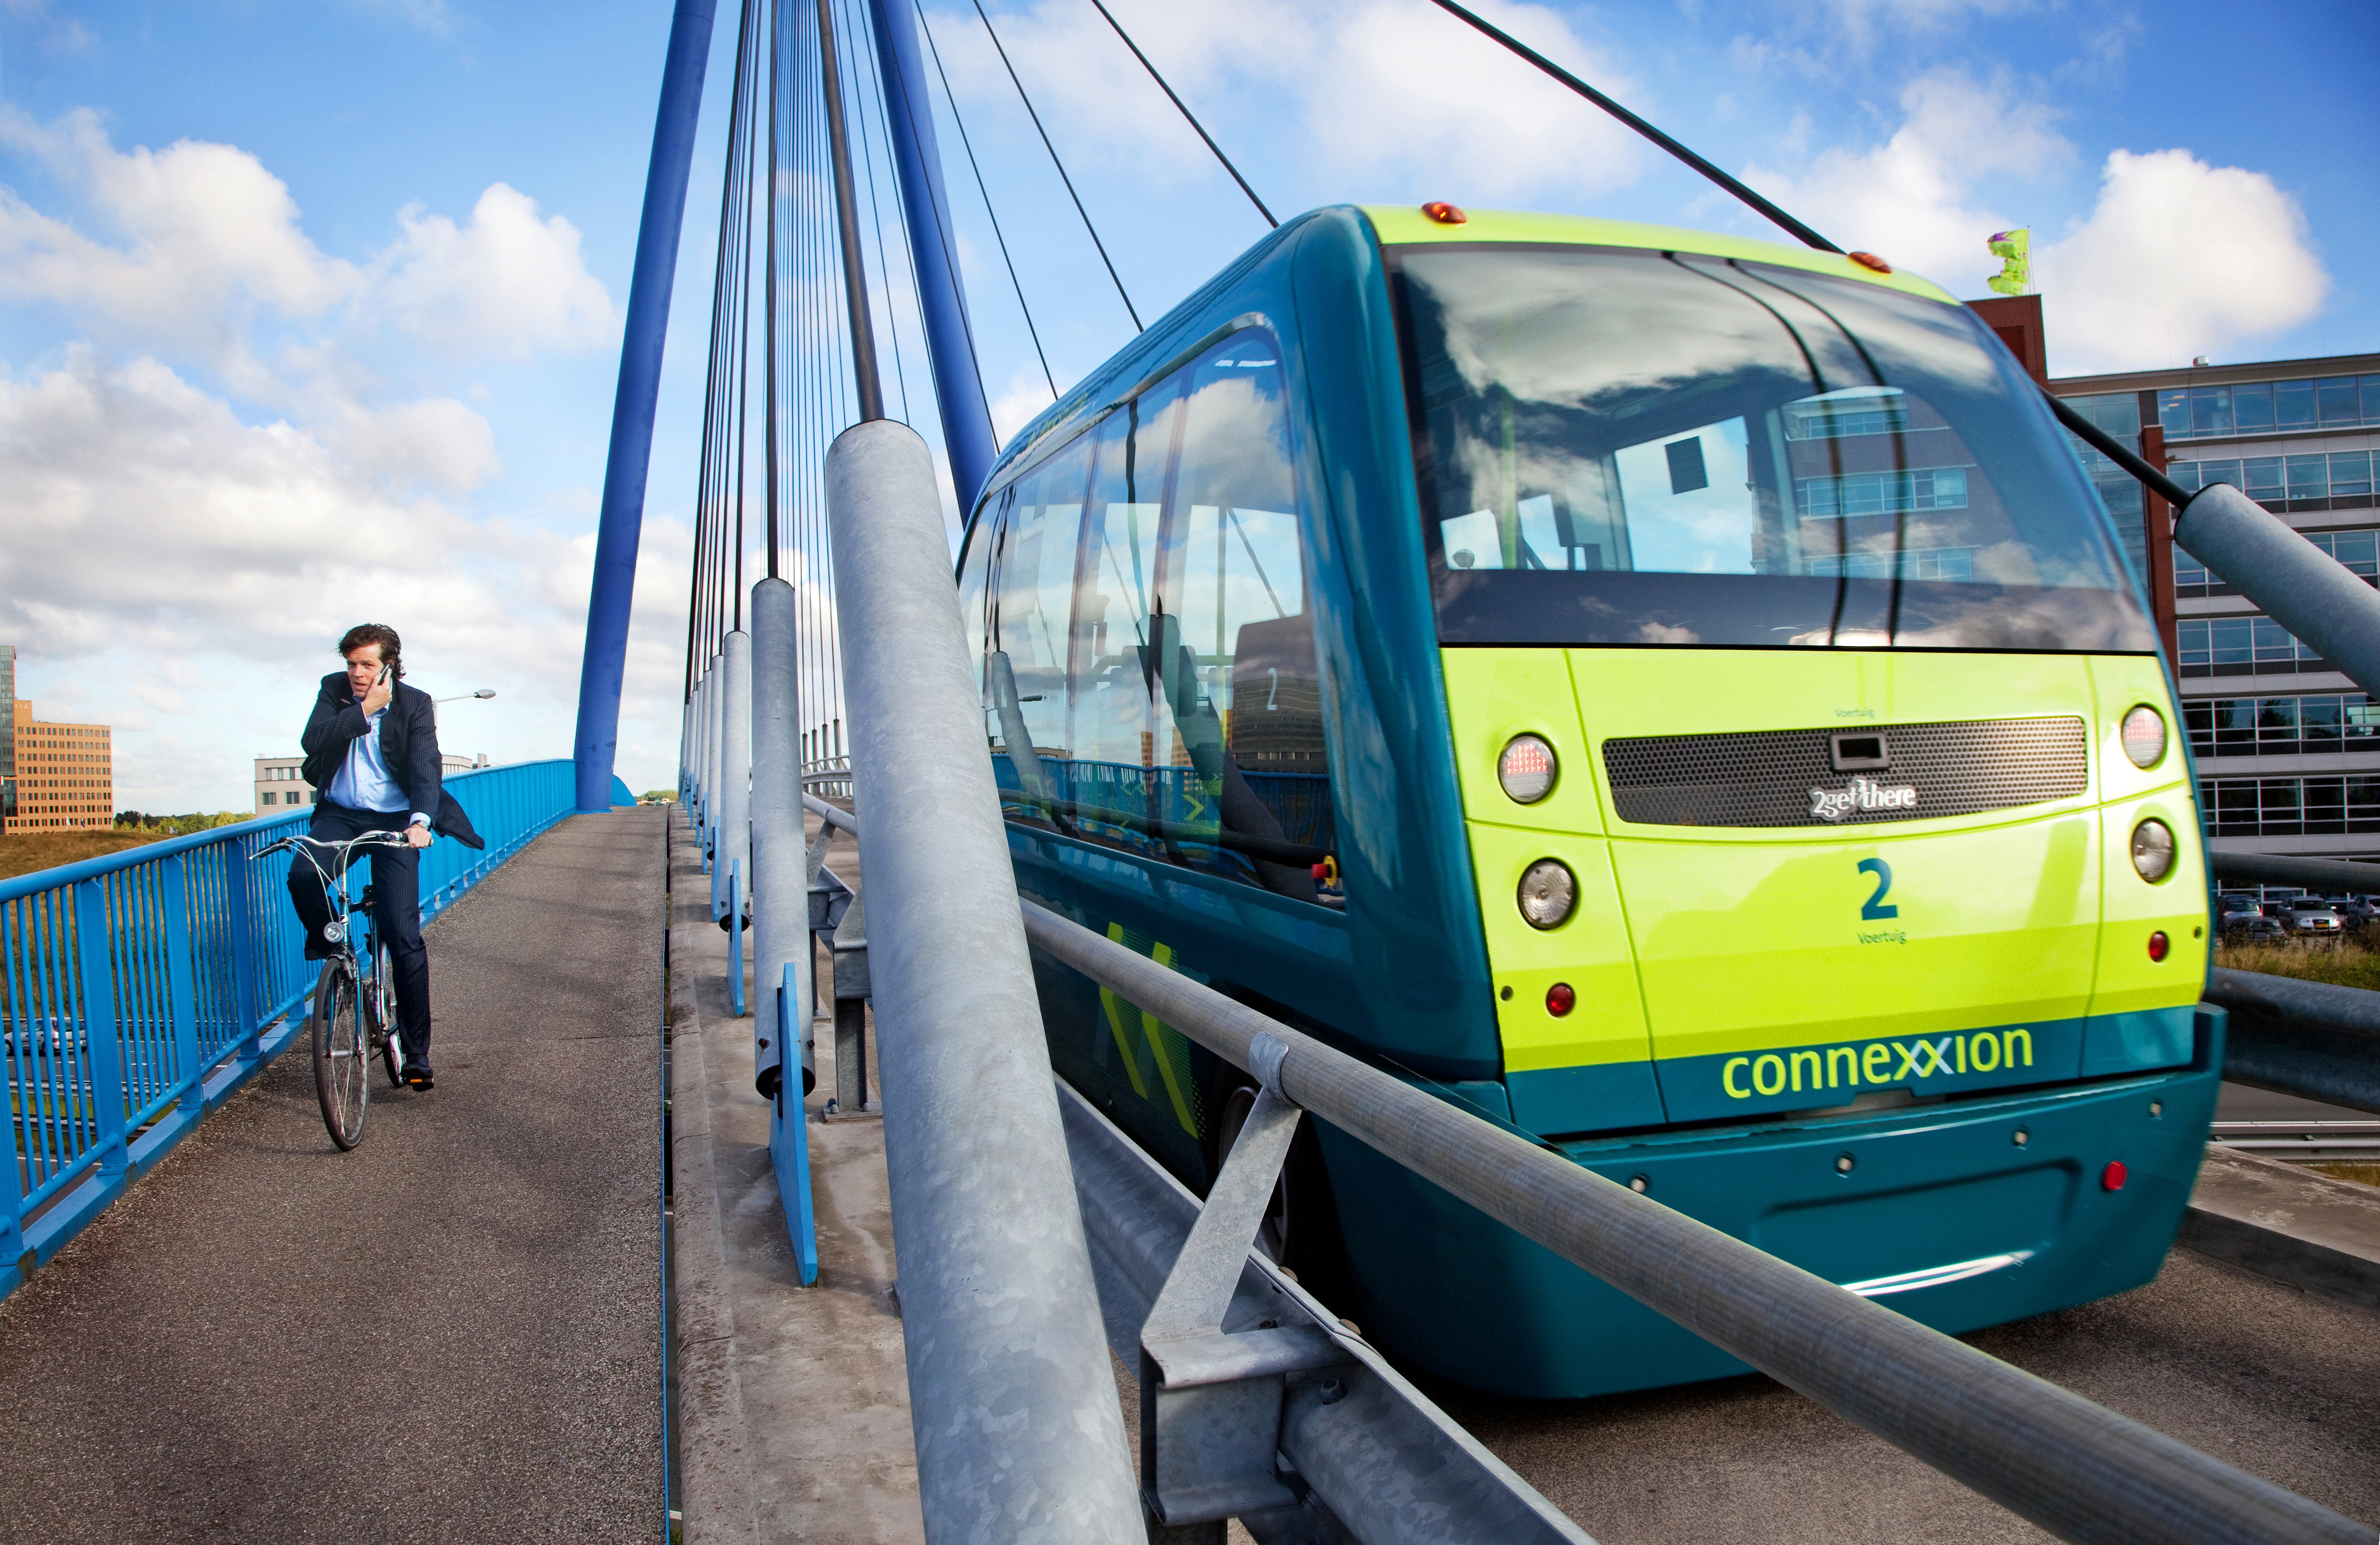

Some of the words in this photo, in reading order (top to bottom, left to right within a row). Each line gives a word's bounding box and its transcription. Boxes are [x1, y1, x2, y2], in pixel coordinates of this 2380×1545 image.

[1267, 667, 1278, 710] 2
[1857, 858, 1899, 921] 2
[1857, 928, 1907, 945] Voertuig
[1722, 1028, 2033, 1099] connexxion
